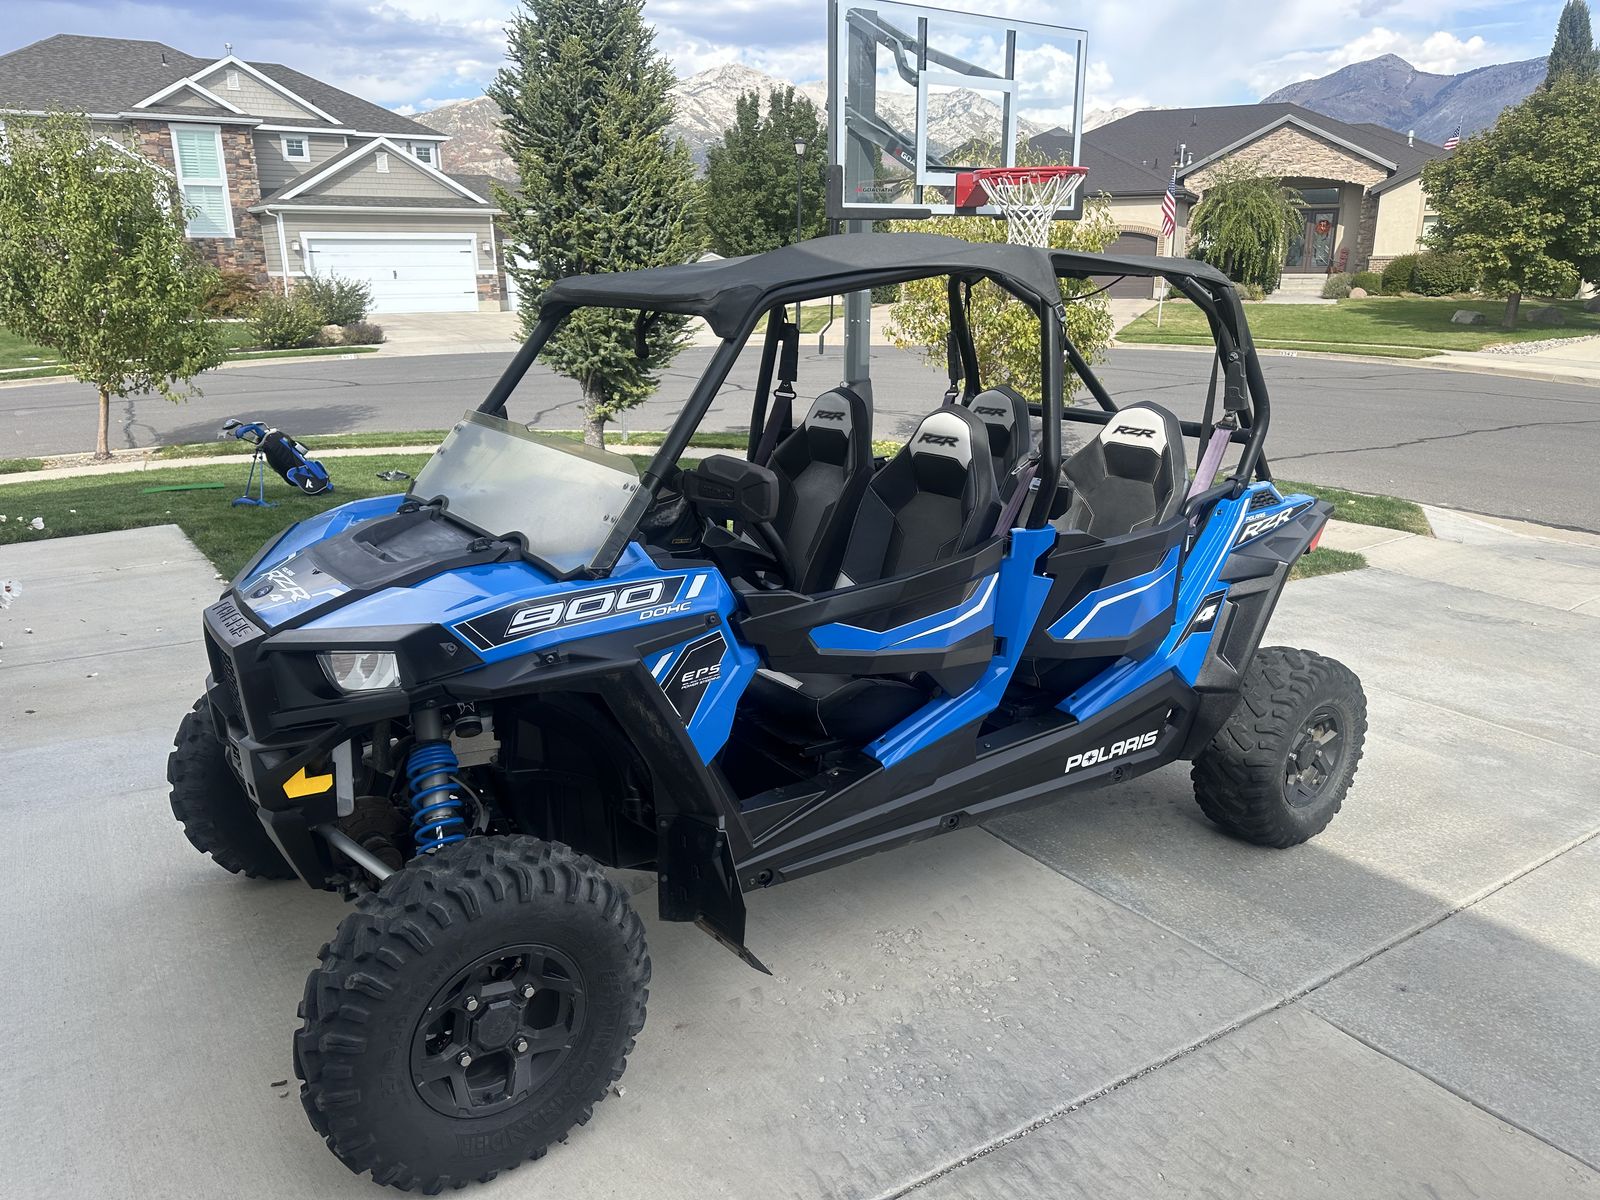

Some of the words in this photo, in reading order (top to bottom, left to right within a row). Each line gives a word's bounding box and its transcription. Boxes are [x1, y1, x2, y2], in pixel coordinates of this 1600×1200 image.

[813, 409, 845, 421] RZR
[973, 405, 1007, 418] RZR
[917, 432, 960, 448] RZR
[1112, 424, 1156, 439] RZR
[1238, 507, 1293, 543] RZR
[260, 570, 311, 602] RZR
[505, 580, 665, 637] 900
[639, 602, 692, 620] DOHC
[1195, 604, 1217, 623] 4
[681, 663, 721, 682] EPS
[1065, 729, 1159, 774] POLARIS
